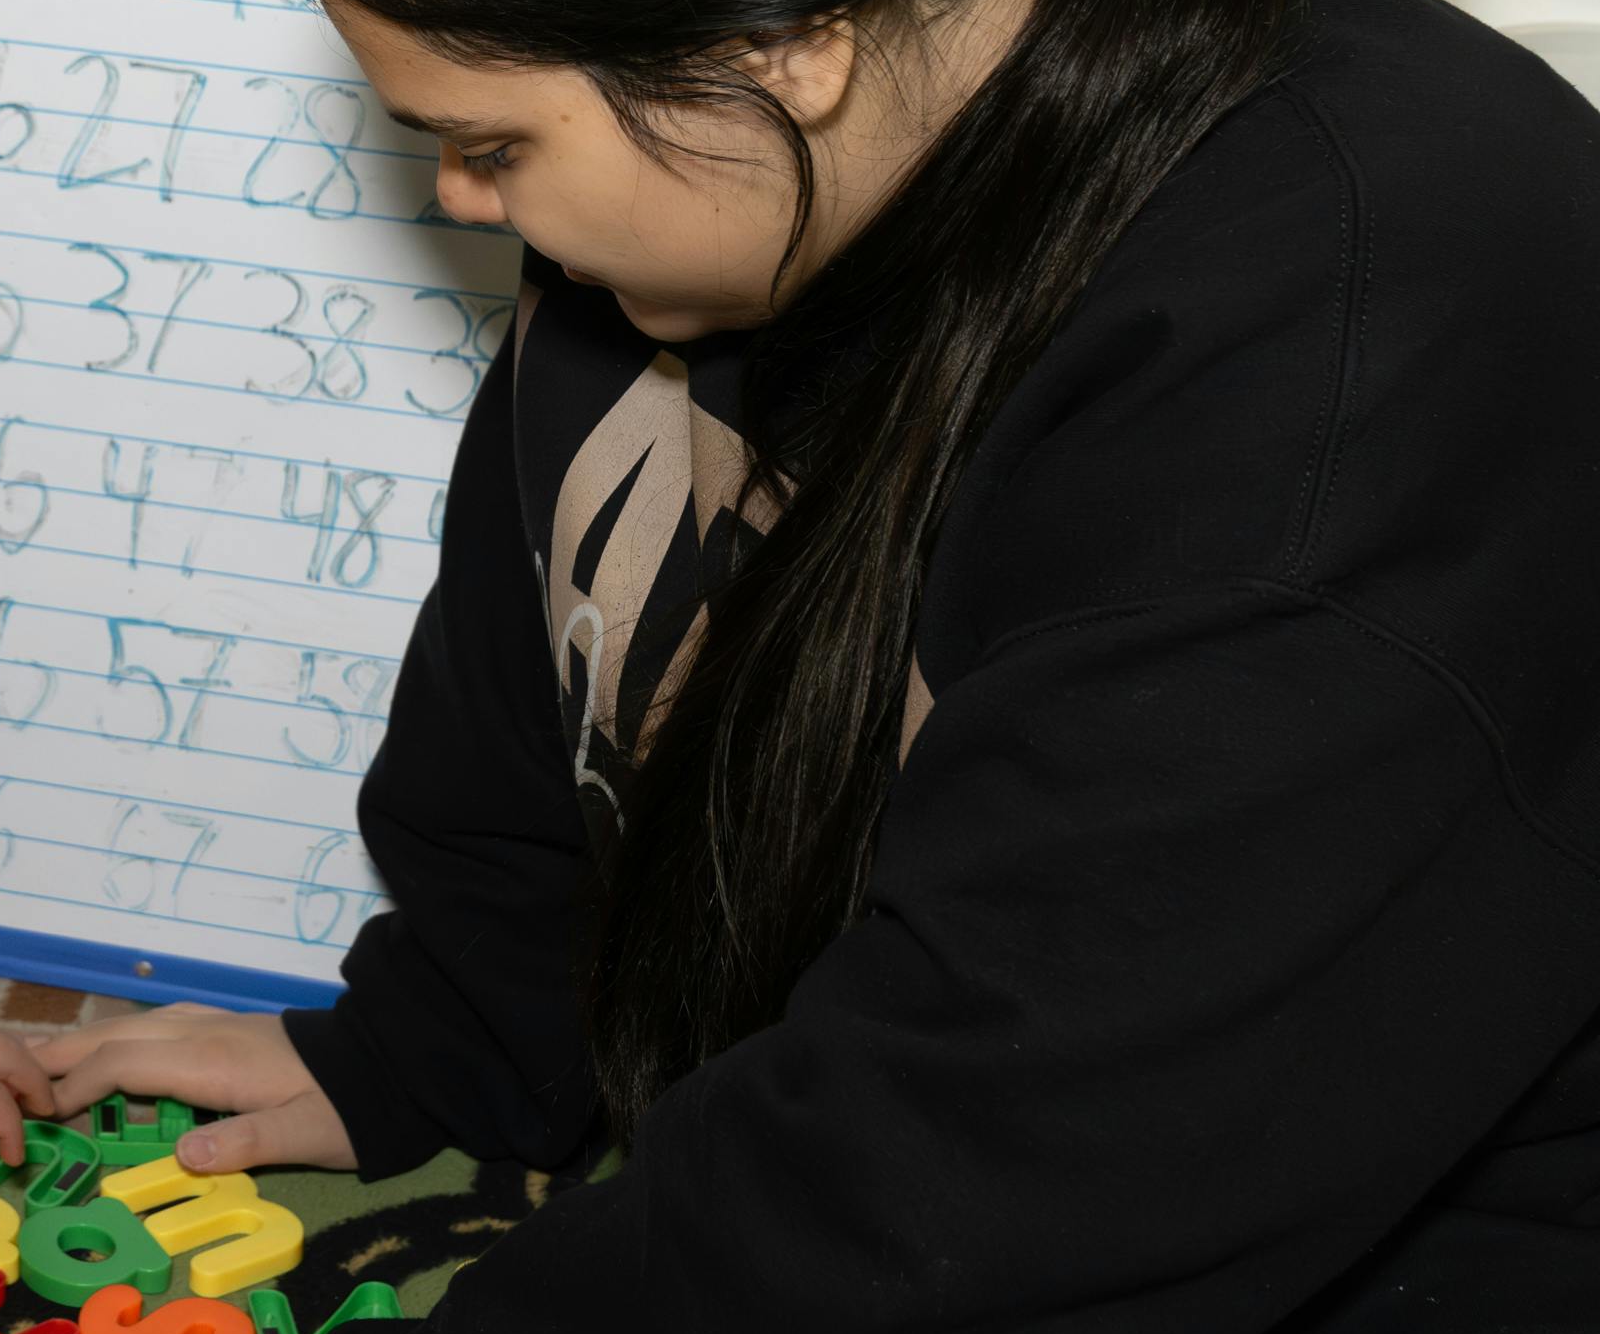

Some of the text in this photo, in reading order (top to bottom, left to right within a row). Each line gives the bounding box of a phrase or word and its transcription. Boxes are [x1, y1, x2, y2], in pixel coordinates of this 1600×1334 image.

[57, 53, 207, 204] 27
[241, 78, 365, 221] 28
[67, 240, 214, 374] 37
[243, 266, 375, 405] 38
[280, 458, 398, 589] 48
[97, 617, 237, 754] 57
